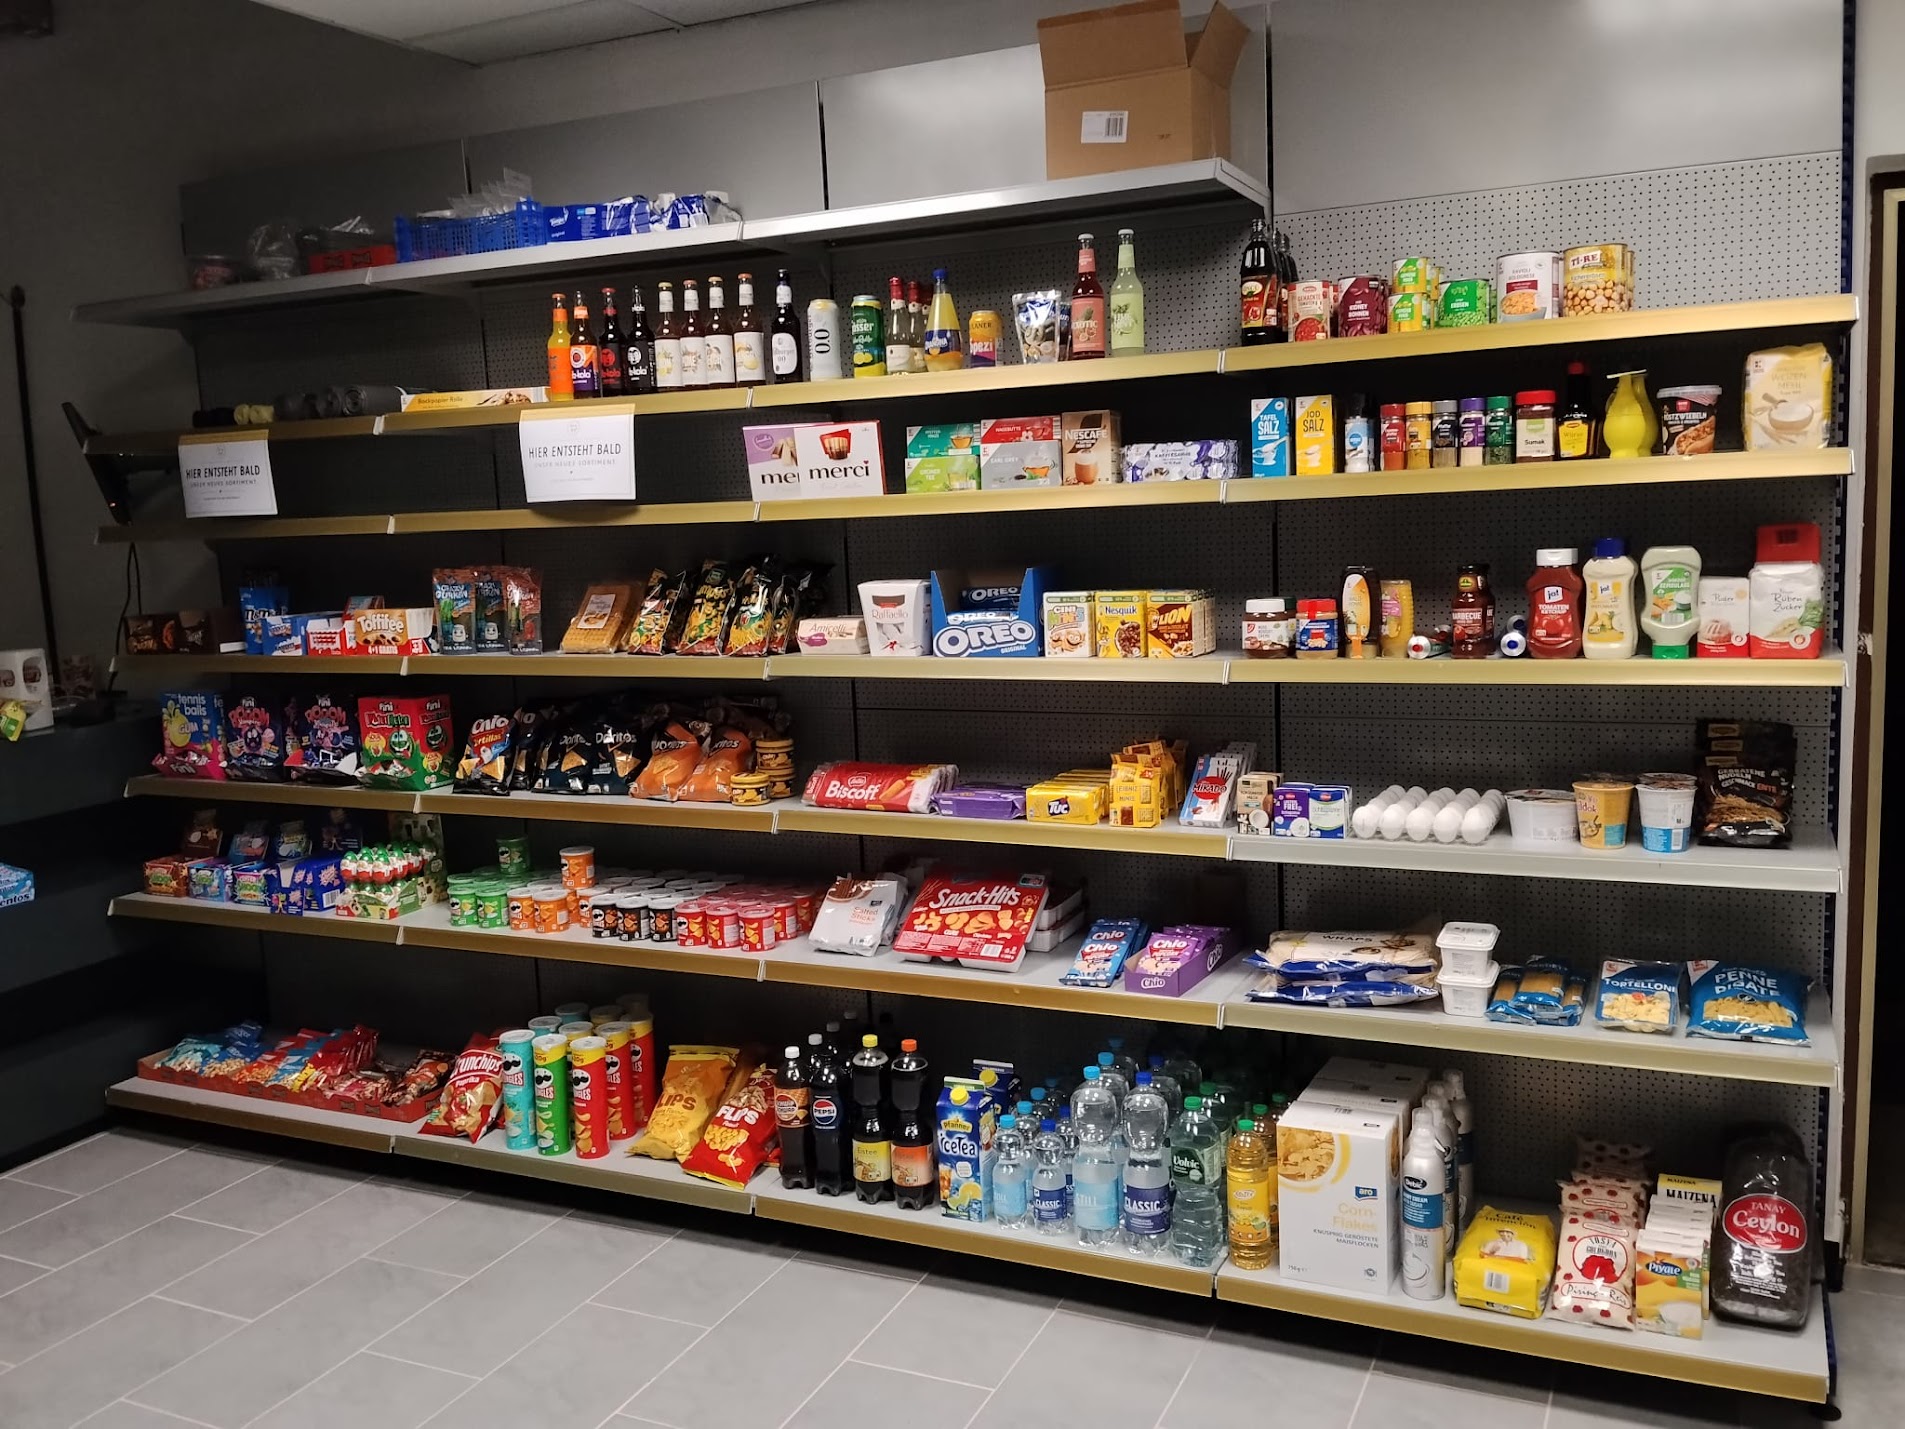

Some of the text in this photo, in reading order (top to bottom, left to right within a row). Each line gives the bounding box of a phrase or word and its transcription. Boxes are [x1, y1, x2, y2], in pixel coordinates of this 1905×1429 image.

[1306, 410, 1320, 419] JOD
[1258, 420, 1280, 435] SALZ
[1303, 419, 1324, 433] SALZ
[529, 443, 622, 459] HIER ENTSTEHT BALD
[186, 465, 260, 479] HIER ENTSTEHT BALD
[809, 460, 870, 480] merci
[971, 587, 1018, 601] OREO
[1105, 605, 1137, 616] Nesquik
[1772, 602, 1803, 612] Zucker
[871, 609, 909, 619] Raffaello
[1159, 605, 1192, 625] LION
[357, 613, 404, 634] Toffifee
[936, 622, 1034, 656] OREO
[178, 693, 206, 705] tennis
[184, 705, 207, 716] balls
[179, 722, 199, 735] GUM
[472, 715, 509, 734] Chio
[1718, 768, 1765, 778] GEBRATENE
[825, 780, 881, 800] Biscoff
[1192, 783, 1227, 793] MIKADO
[929, 886, 1021, 909] Snack-Hits
[1092, 930, 1125, 940] Chio
[1323, 934, 1373, 943] WRAPS
[1085, 943, 1119, 952] Chio
[1153, 939, 1188, 949] Chio
[1142, 977, 1164, 987] Chio
[1715, 972, 1778, 989] PENNE
[717, 1105, 759, 1125] FLIPS
[1173, 1155, 1200, 1170] Volvic
[1667, 1178, 1696, 1186] MAIZENA
[1358, 1188, 1373, 1196] aro
[1666, 1188, 1717, 1208] MAIZENA
[1035, 1199, 1061, 1209] CLASSIC
[1125, 1197, 1161, 1212] CLASSIC
[1751, 1202, 1786, 1214] TANAY
[1332, 1215, 1378, 1232] Flakes
[1733, 1210, 1800, 1239] Ceylon
[1313, 1229, 1378, 1242] KNUSPRIG GERÖSTETE
[1336, 1238, 1379, 1249] MAISFLOCKEN
